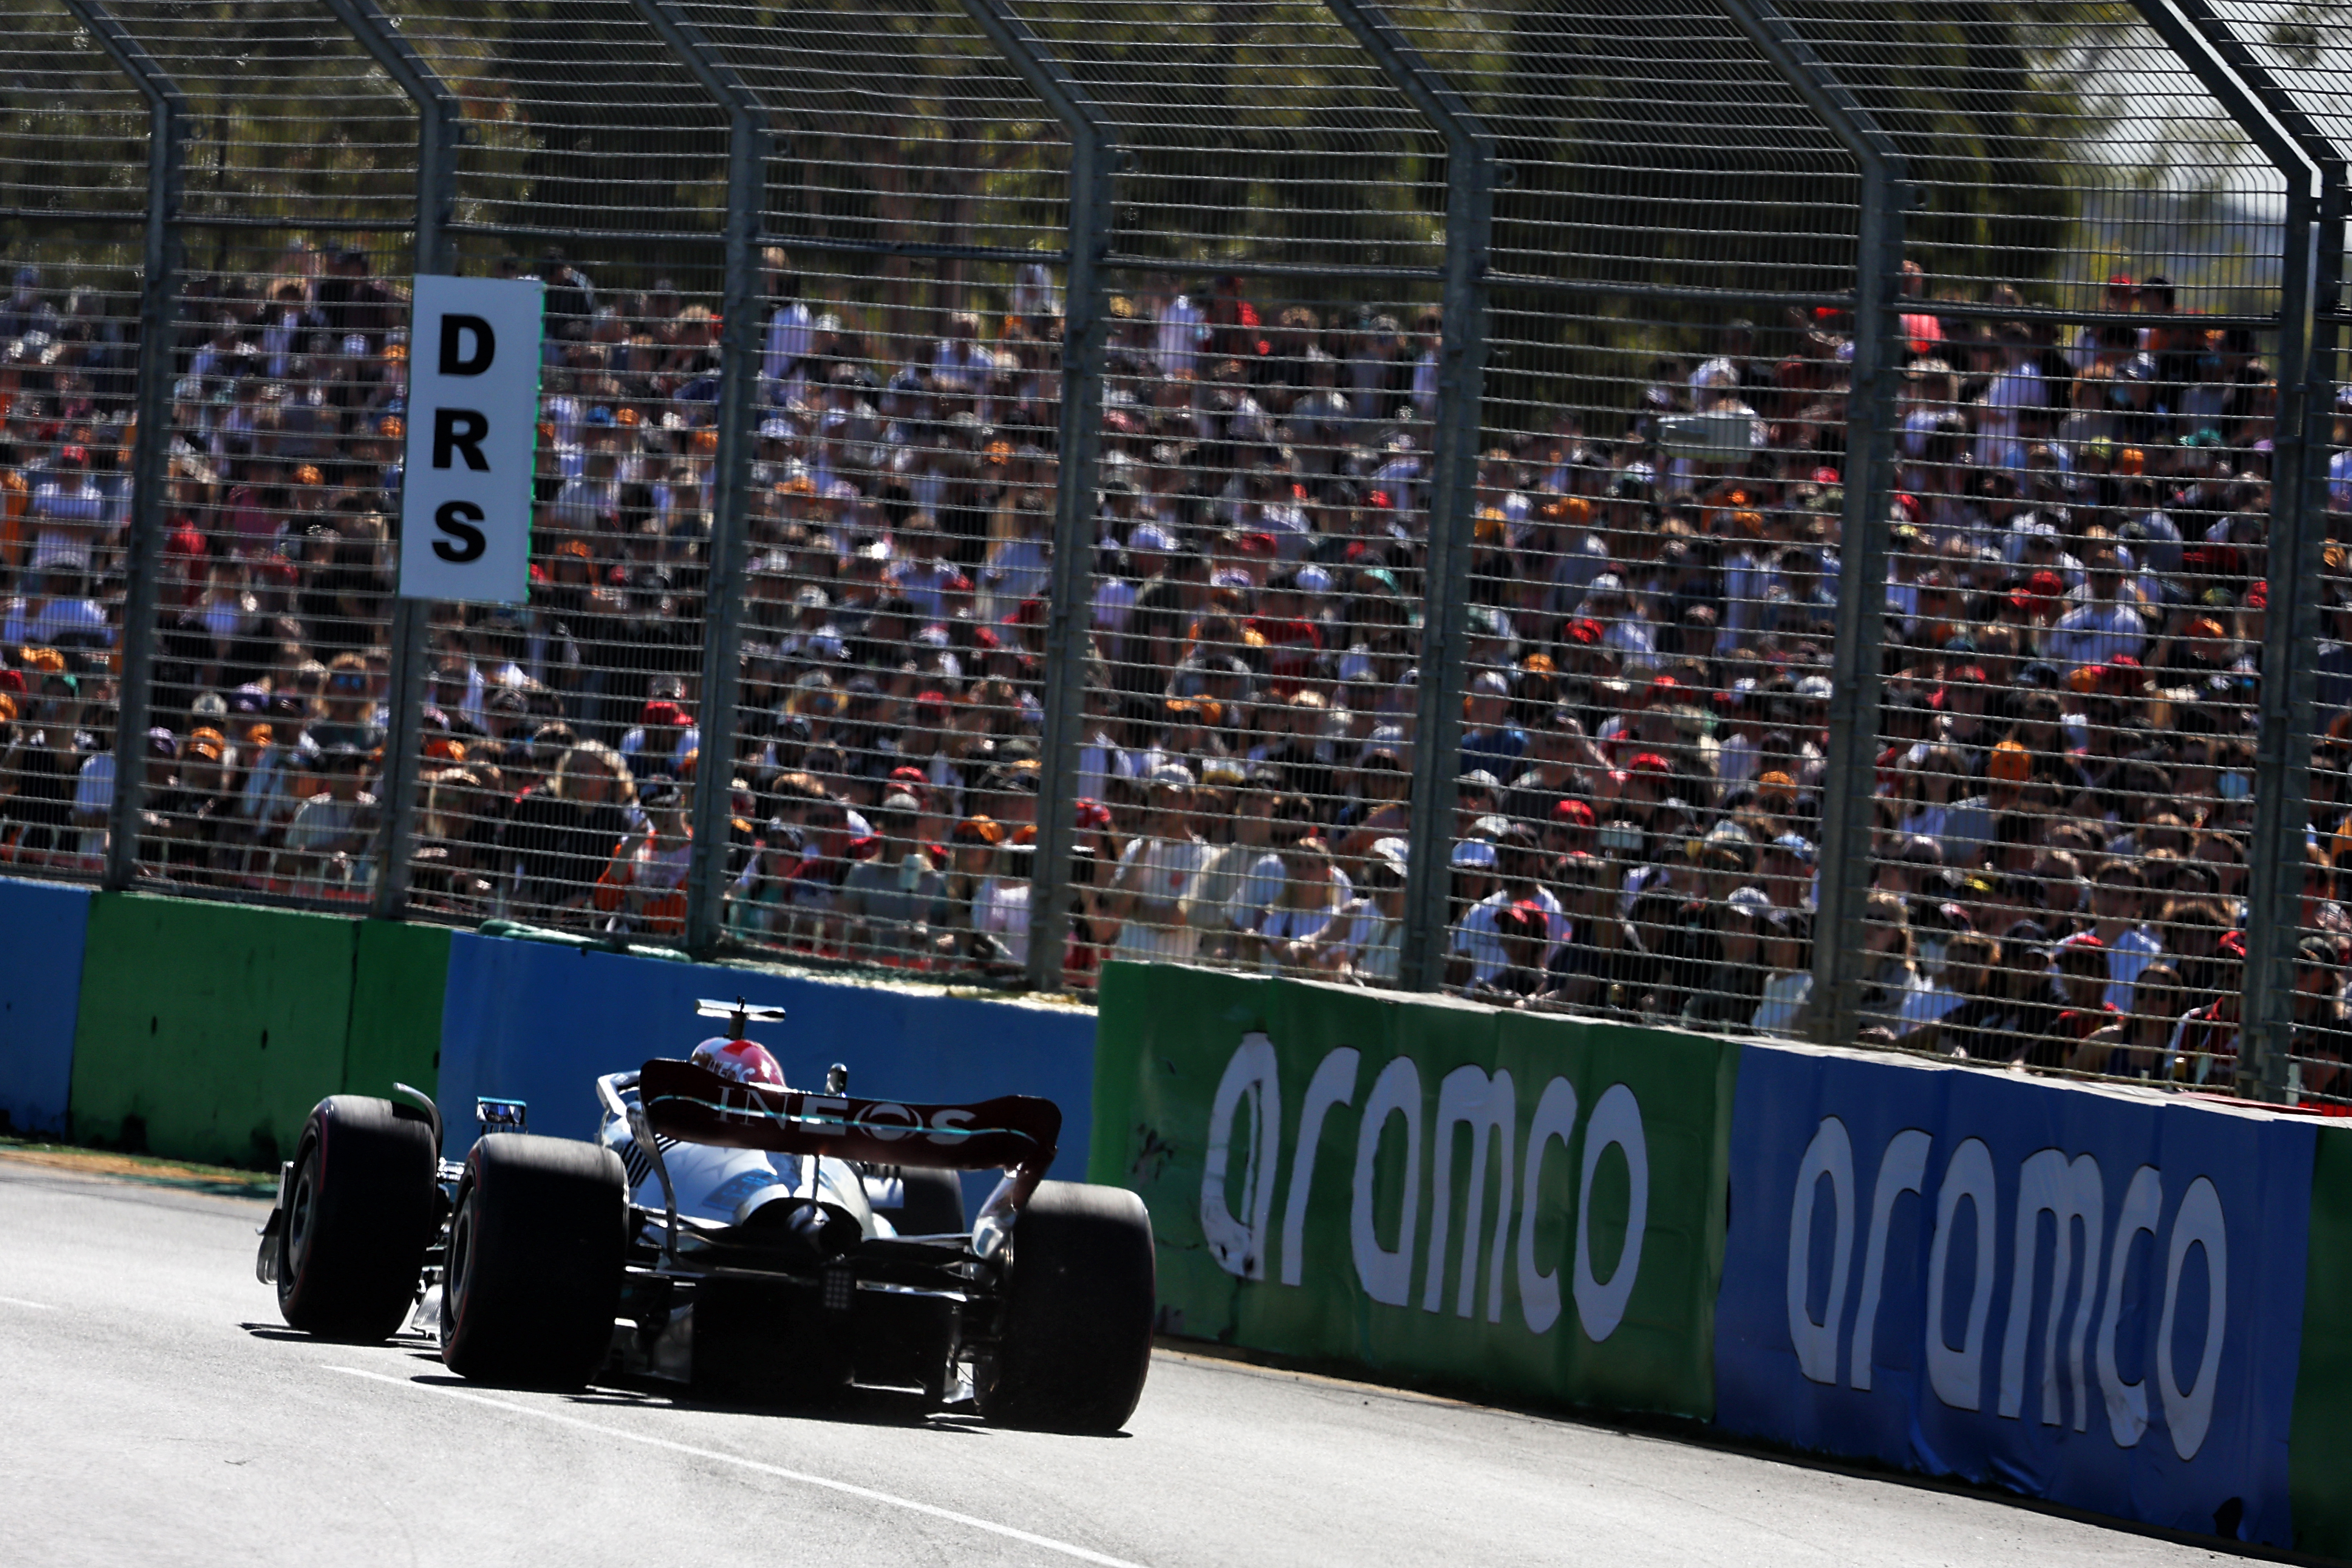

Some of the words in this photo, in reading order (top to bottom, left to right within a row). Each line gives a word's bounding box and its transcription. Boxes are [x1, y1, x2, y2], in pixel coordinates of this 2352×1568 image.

[432, 314, 495, 564] DRS
[718, 1086, 976, 1145] INEOS
[1201, 1031, 1648, 1342] aramco
[1787, 1115, 2227, 1460] aramco
